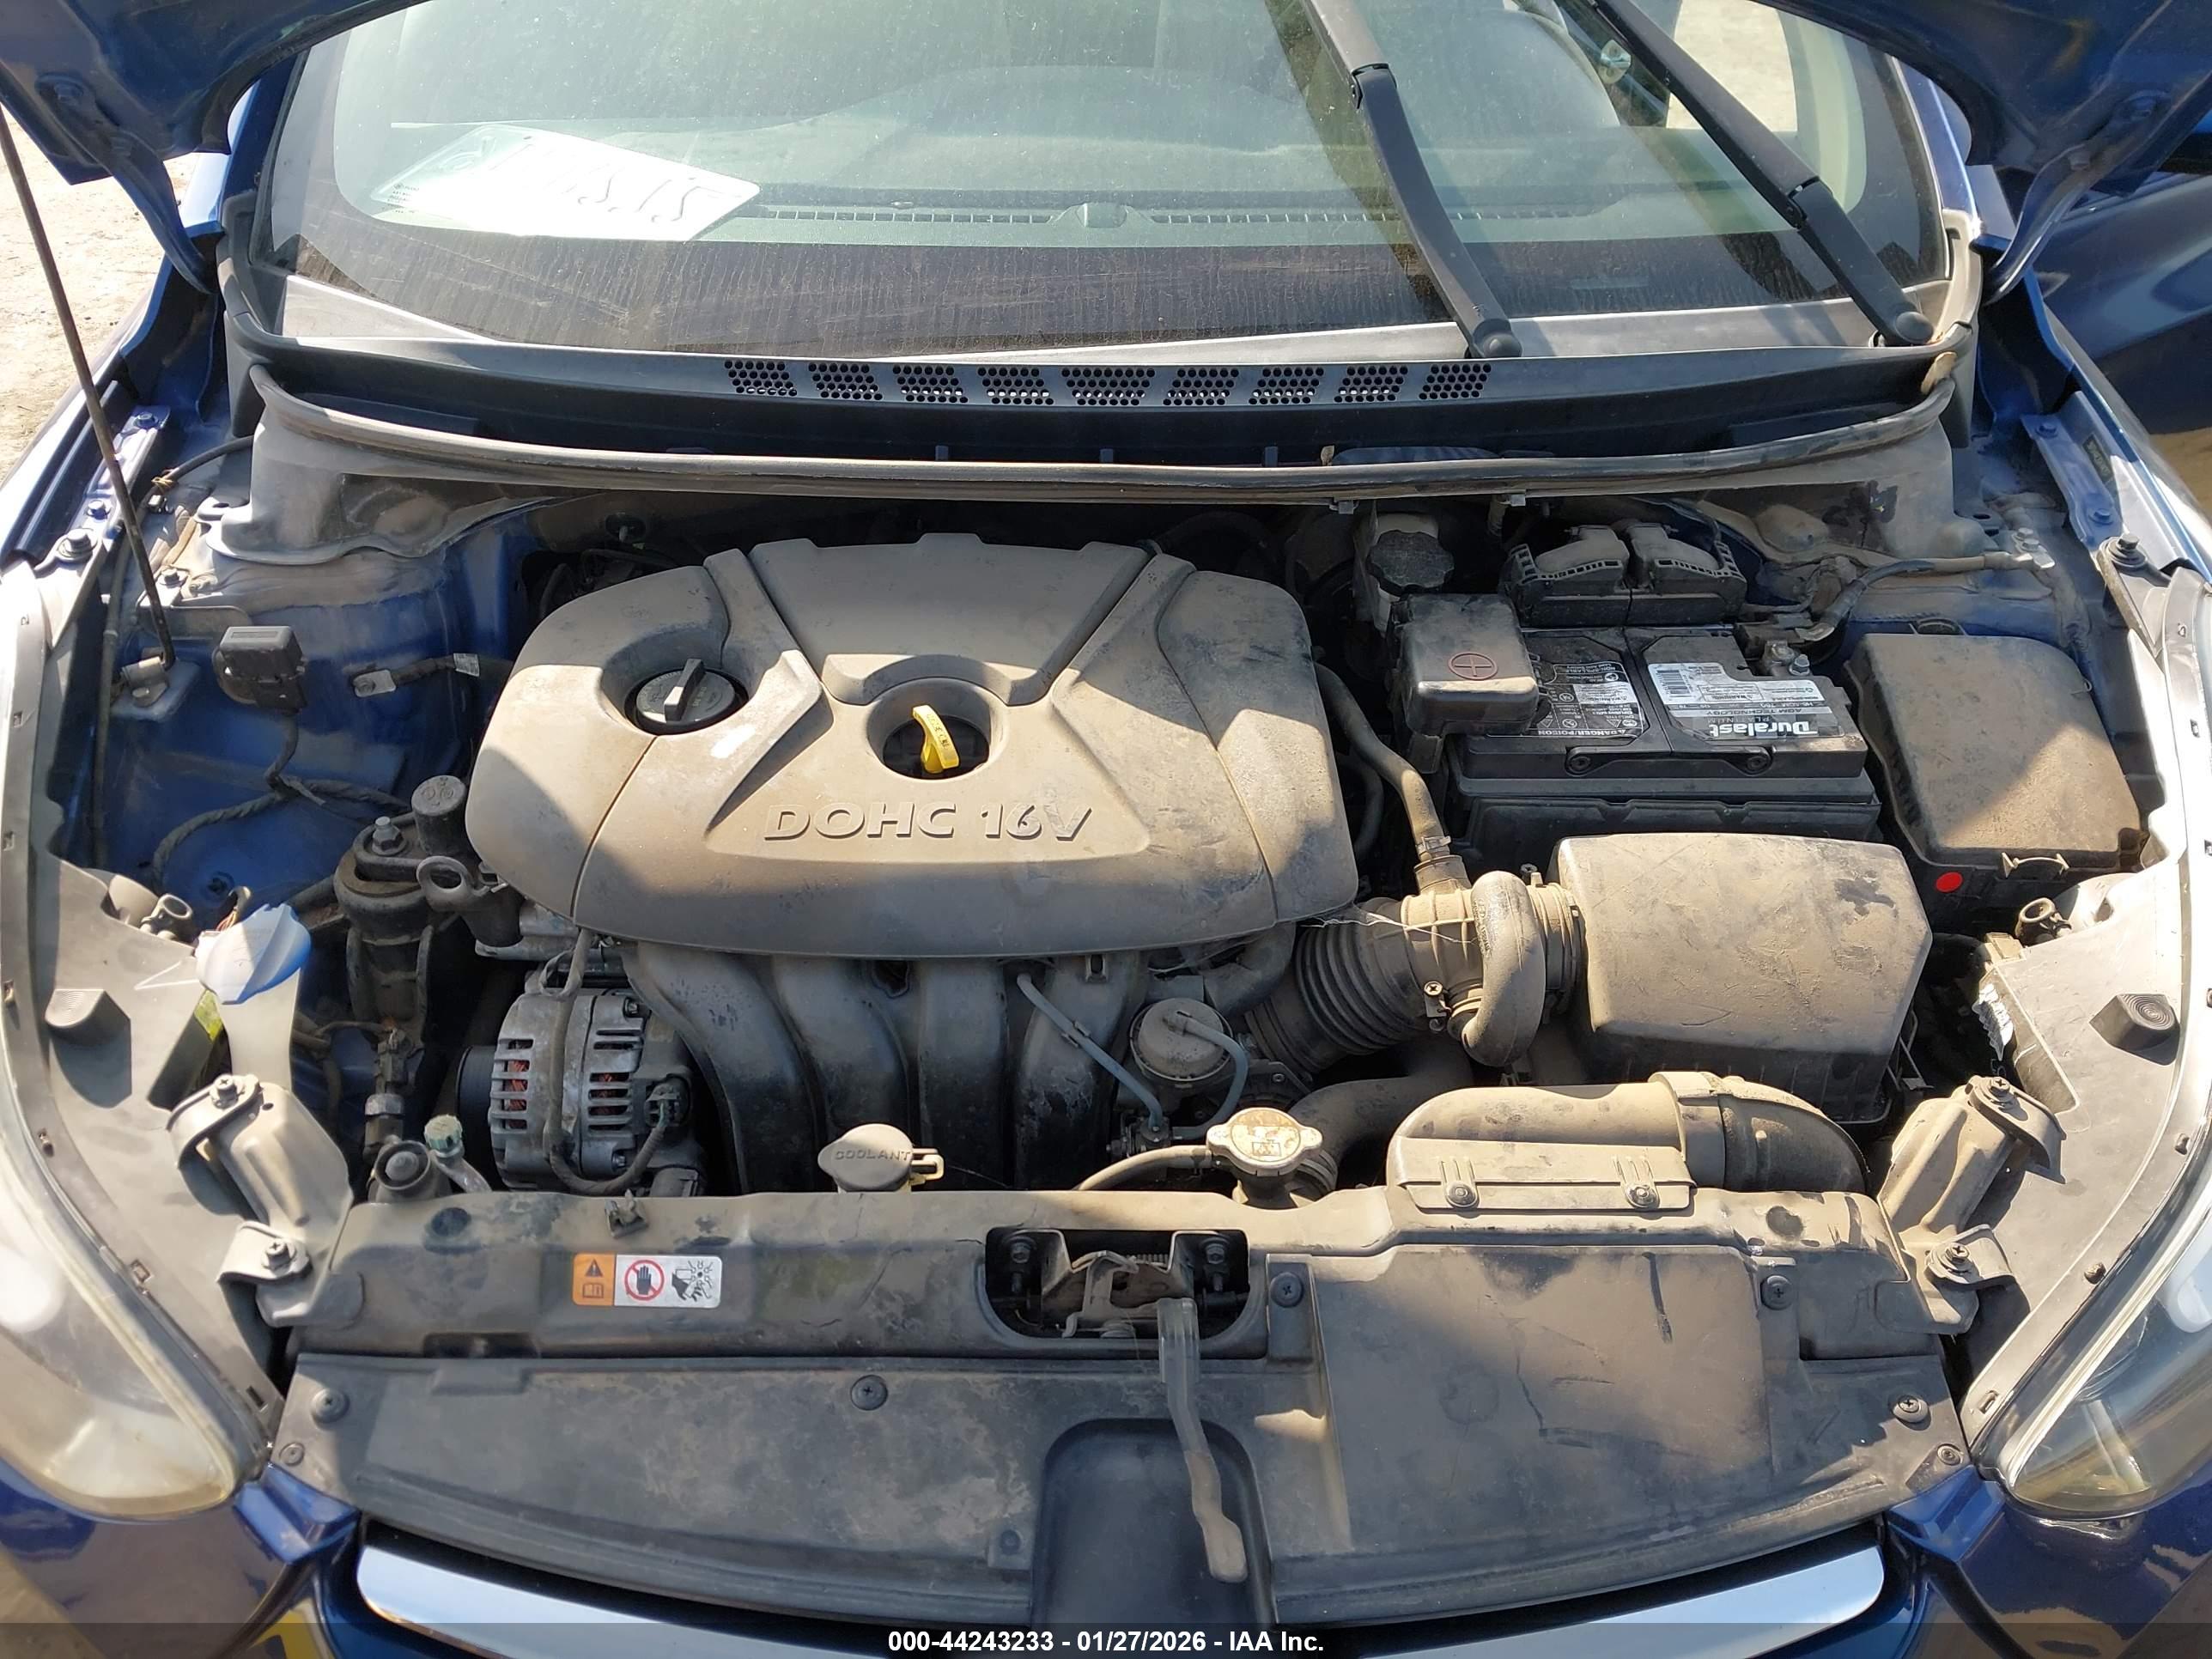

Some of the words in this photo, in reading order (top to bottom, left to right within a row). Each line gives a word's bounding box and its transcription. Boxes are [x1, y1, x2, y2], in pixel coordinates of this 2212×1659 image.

[1709, 721, 1818, 737] Duralast
[764, 802, 957, 842] DOHC
[981, 803, 1092, 842] 16V
[835, 1149, 911, 1161] COOLANT
